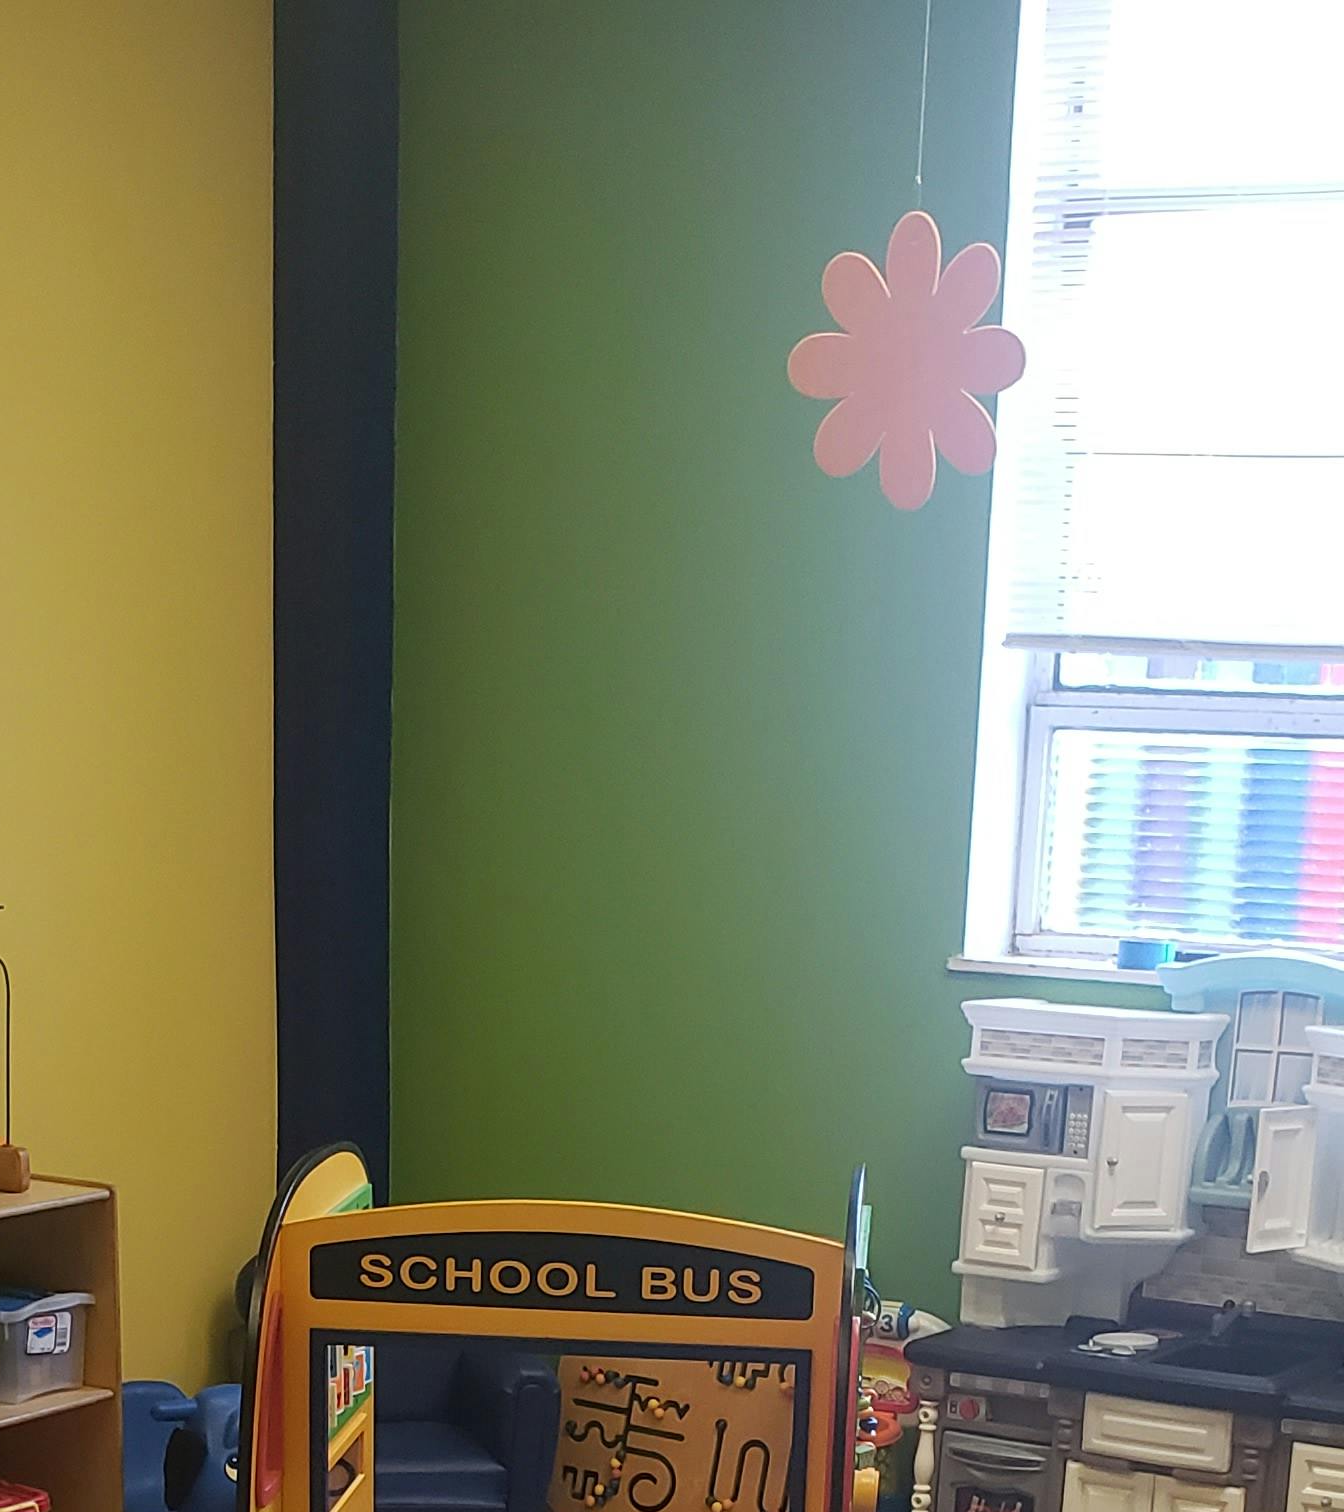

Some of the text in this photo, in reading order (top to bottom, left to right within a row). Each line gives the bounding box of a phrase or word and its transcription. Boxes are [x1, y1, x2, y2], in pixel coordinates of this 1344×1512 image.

[359, 1253, 763, 1305] SCHOOL BUS
[879, 1313, 894, 1333] 3
